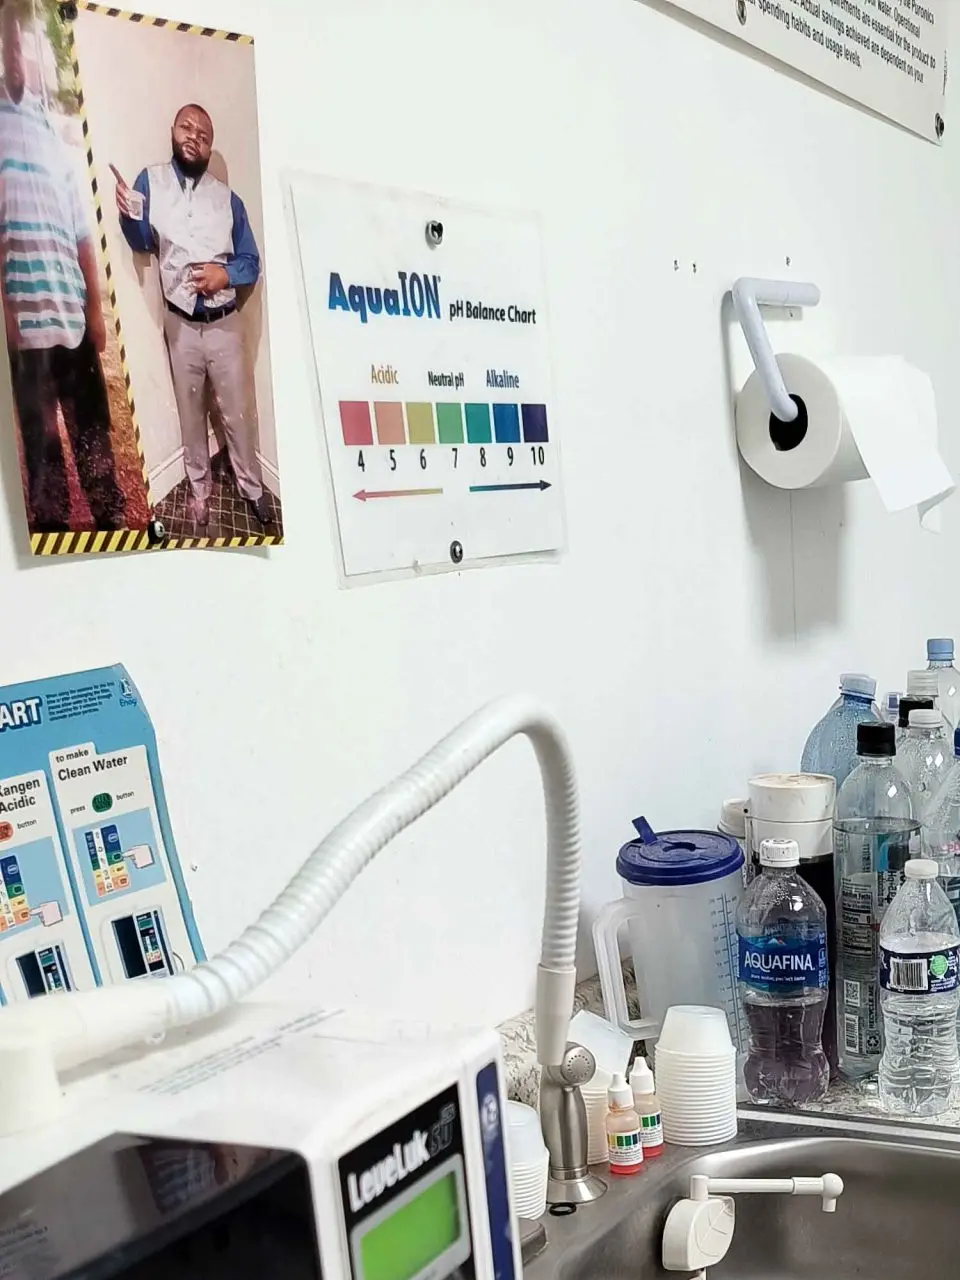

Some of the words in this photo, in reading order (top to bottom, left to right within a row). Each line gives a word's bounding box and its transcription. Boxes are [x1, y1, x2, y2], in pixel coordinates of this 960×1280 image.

[759, 0, 790, 30] spending
[791, 11, 812, 39] habits
[812, 28, 825, 46] and
[825, 36, 843, 59] usage
[843, 43, 862, 68] levels.
[821, 9, 845, 37] savings
[845, 24, 871, 50] achieved
[871, 40, 880, 56] are
[880, 43, 907, 73] dependent
[907, 63, 914, 77] on
[861, 11, 871, 27] are
[871, 18, 895, 43] essential
[895, 30, 903, 48] for
[903, 36, 911, 53] the
[911, 44, 929, 66] product
[929, 54, 936, 69] to
[328, 270, 441, 324] AquaION
[449, 300, 464, 322] pH
[466, 301, 506, 322] Balance
[507, 305, 537, 324] Chart
[371, 364, 399, 385] Acidic
[427, 370, 454, 388] Neutral
[454, 373, 465, 391] pH
[486, 368, 520, 389] Alkaline
[358, 449, 366, 472] 4
[389, 449, 397, 471] 5
[419, 448, 427, 470] 6
[451, 447, 458, 469] 7
[479, 447, 487, 468] 8
[507, 446, 514, 467] 9
[530, 446, 545, 466] 10
[0, 697, 41, 730] ART
[55, 754, 65, 763] to
[66, 749, 89, 761] make
[58, 764, 92, 782] Clean
[93, 755, 128, 773] Water
[0, 795, 36, 813] Acidic
[116, 791, 135, 801] button
[70, 805, 86, 815] press
[17, 818, 37, 830] button
[744, 951, 814, 973] AQUAFINA
